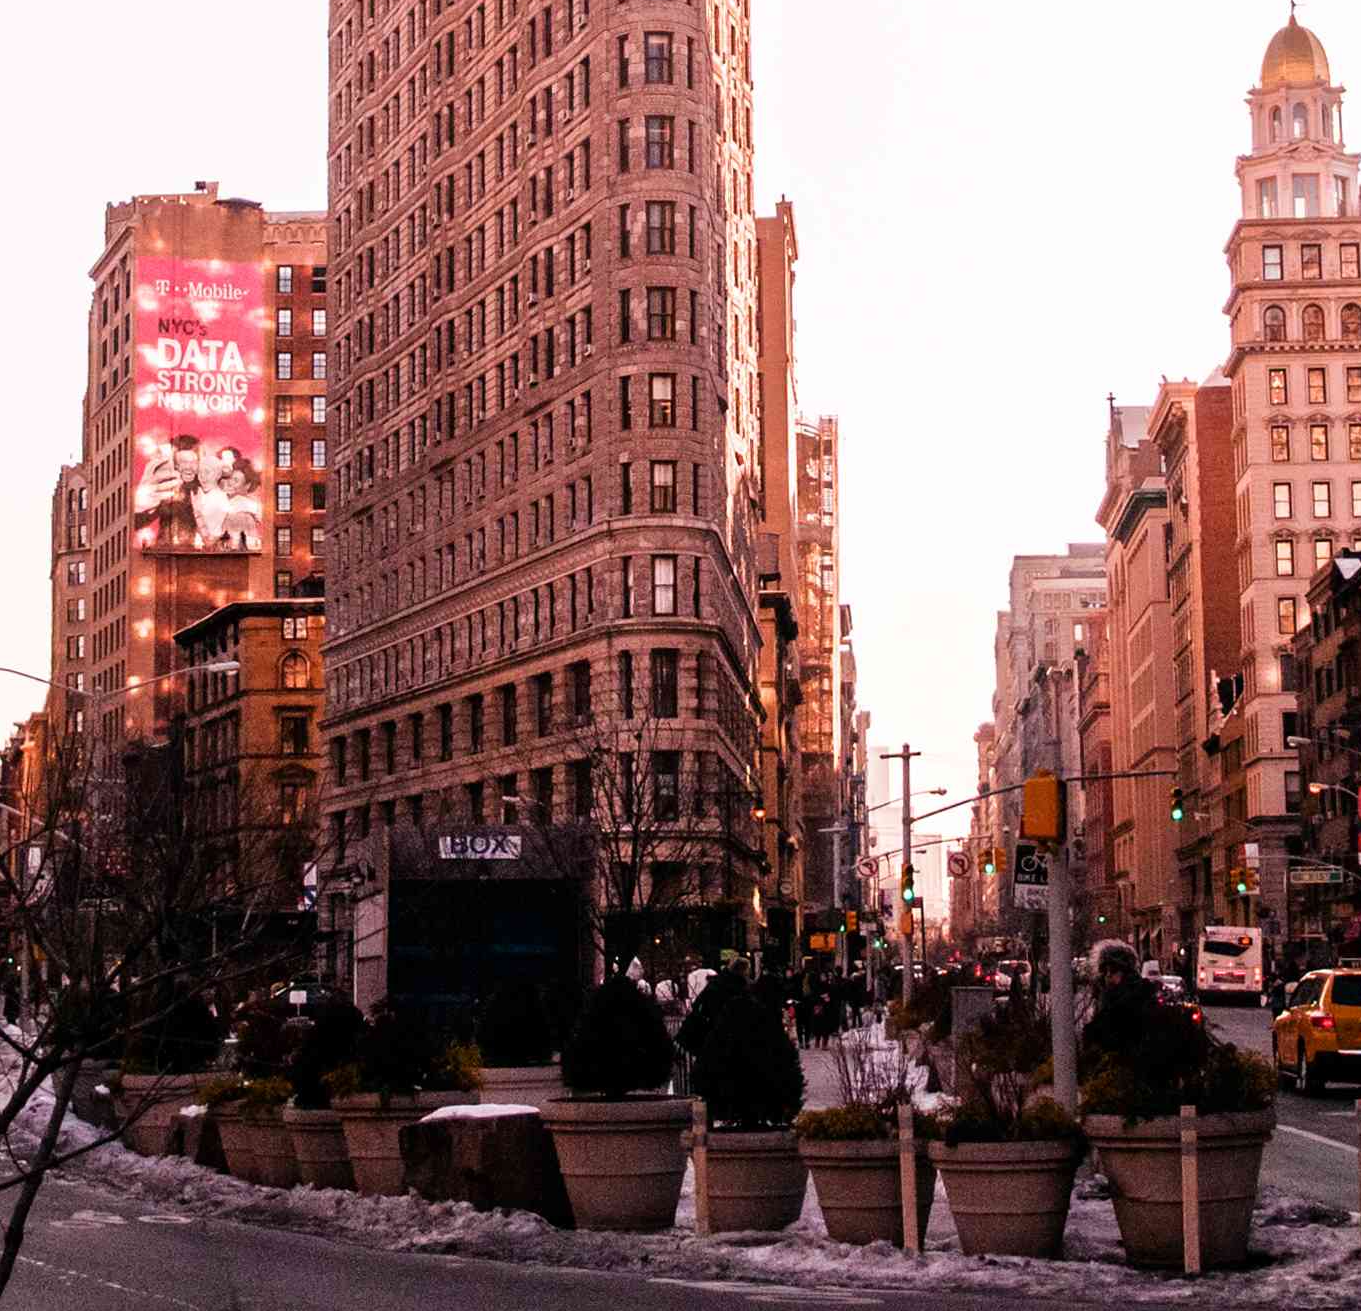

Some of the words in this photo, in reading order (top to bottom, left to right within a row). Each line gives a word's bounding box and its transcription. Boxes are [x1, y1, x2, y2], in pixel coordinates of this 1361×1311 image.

[158, 317, 208, 337] NYC's
[158, 337, 246, 372] DATA
[158, 370, 248, 394] STRONG
[450, 831, 509, 855] BOX
